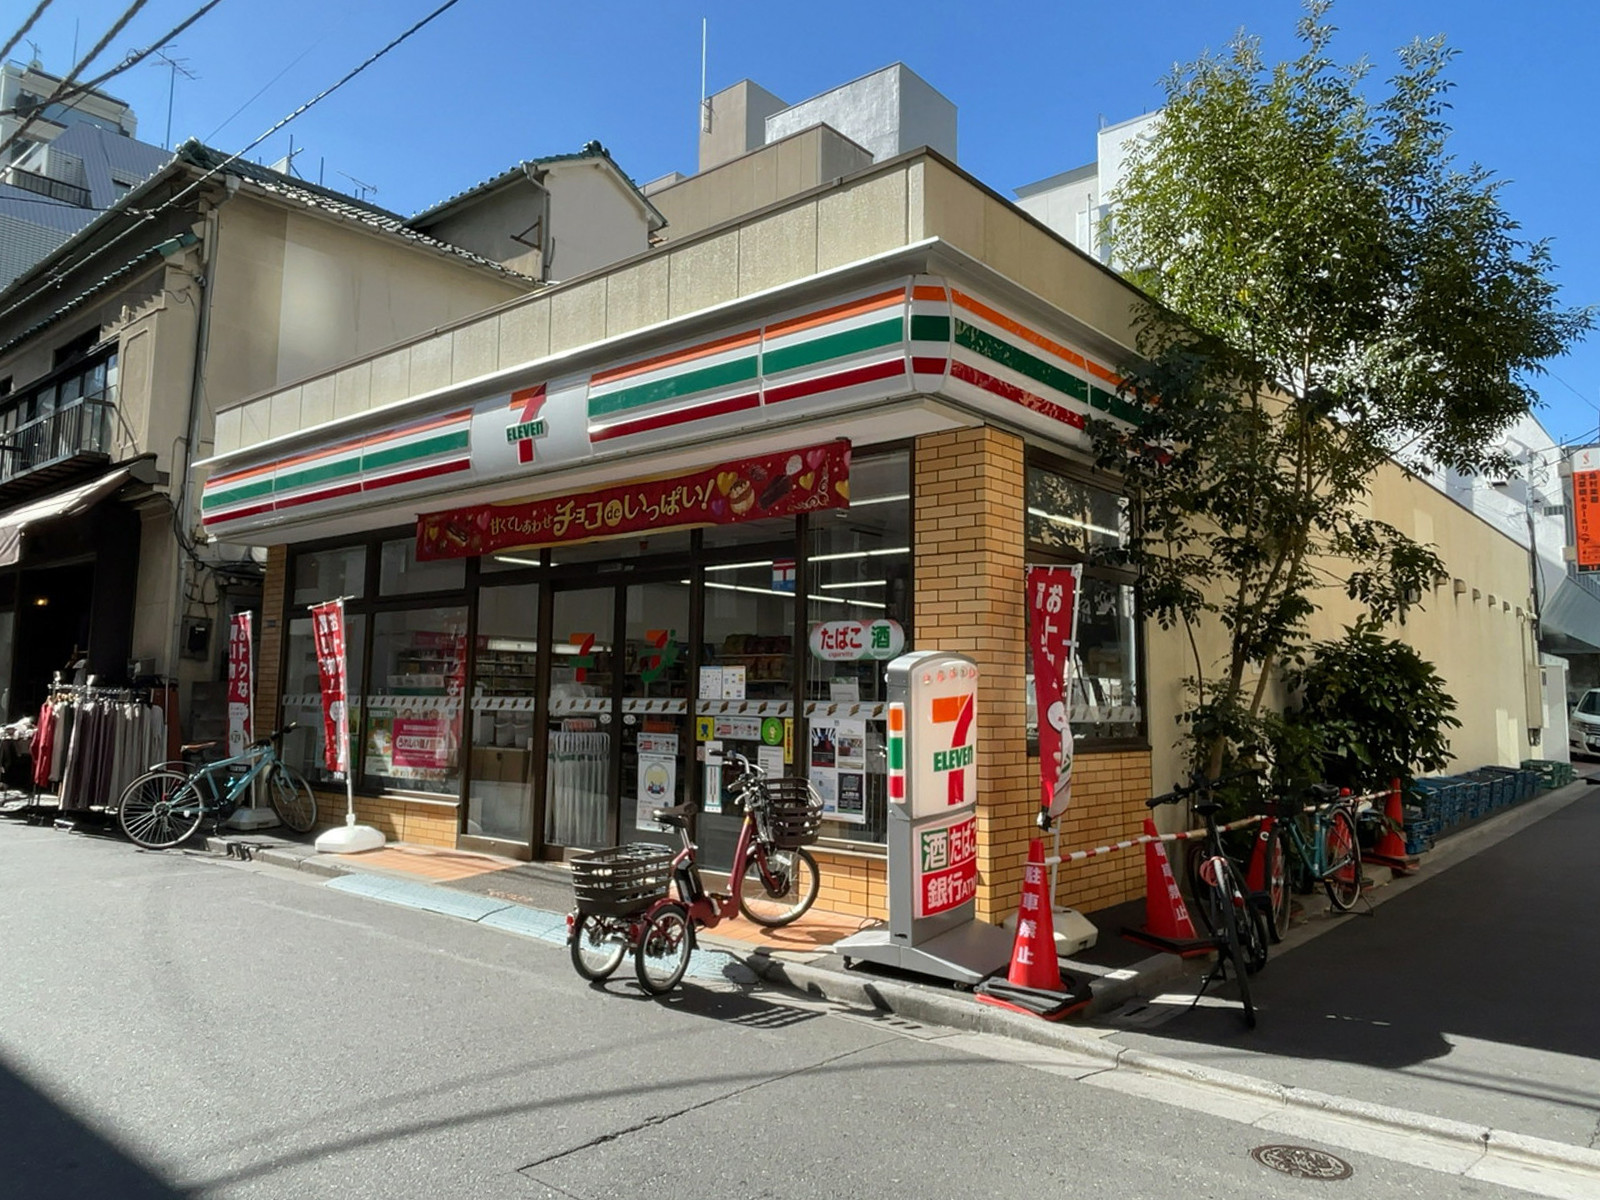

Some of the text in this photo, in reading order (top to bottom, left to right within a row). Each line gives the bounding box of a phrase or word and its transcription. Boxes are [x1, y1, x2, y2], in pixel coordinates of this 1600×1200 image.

[510, 382, 547, 464] 7
[821, 625, 891, 650] たばこ 酒
[932, 692, 974, 806] 7
[922, 831, 948, 872] 酒
[1017, 866, 1041, 965] 駐車禁止
